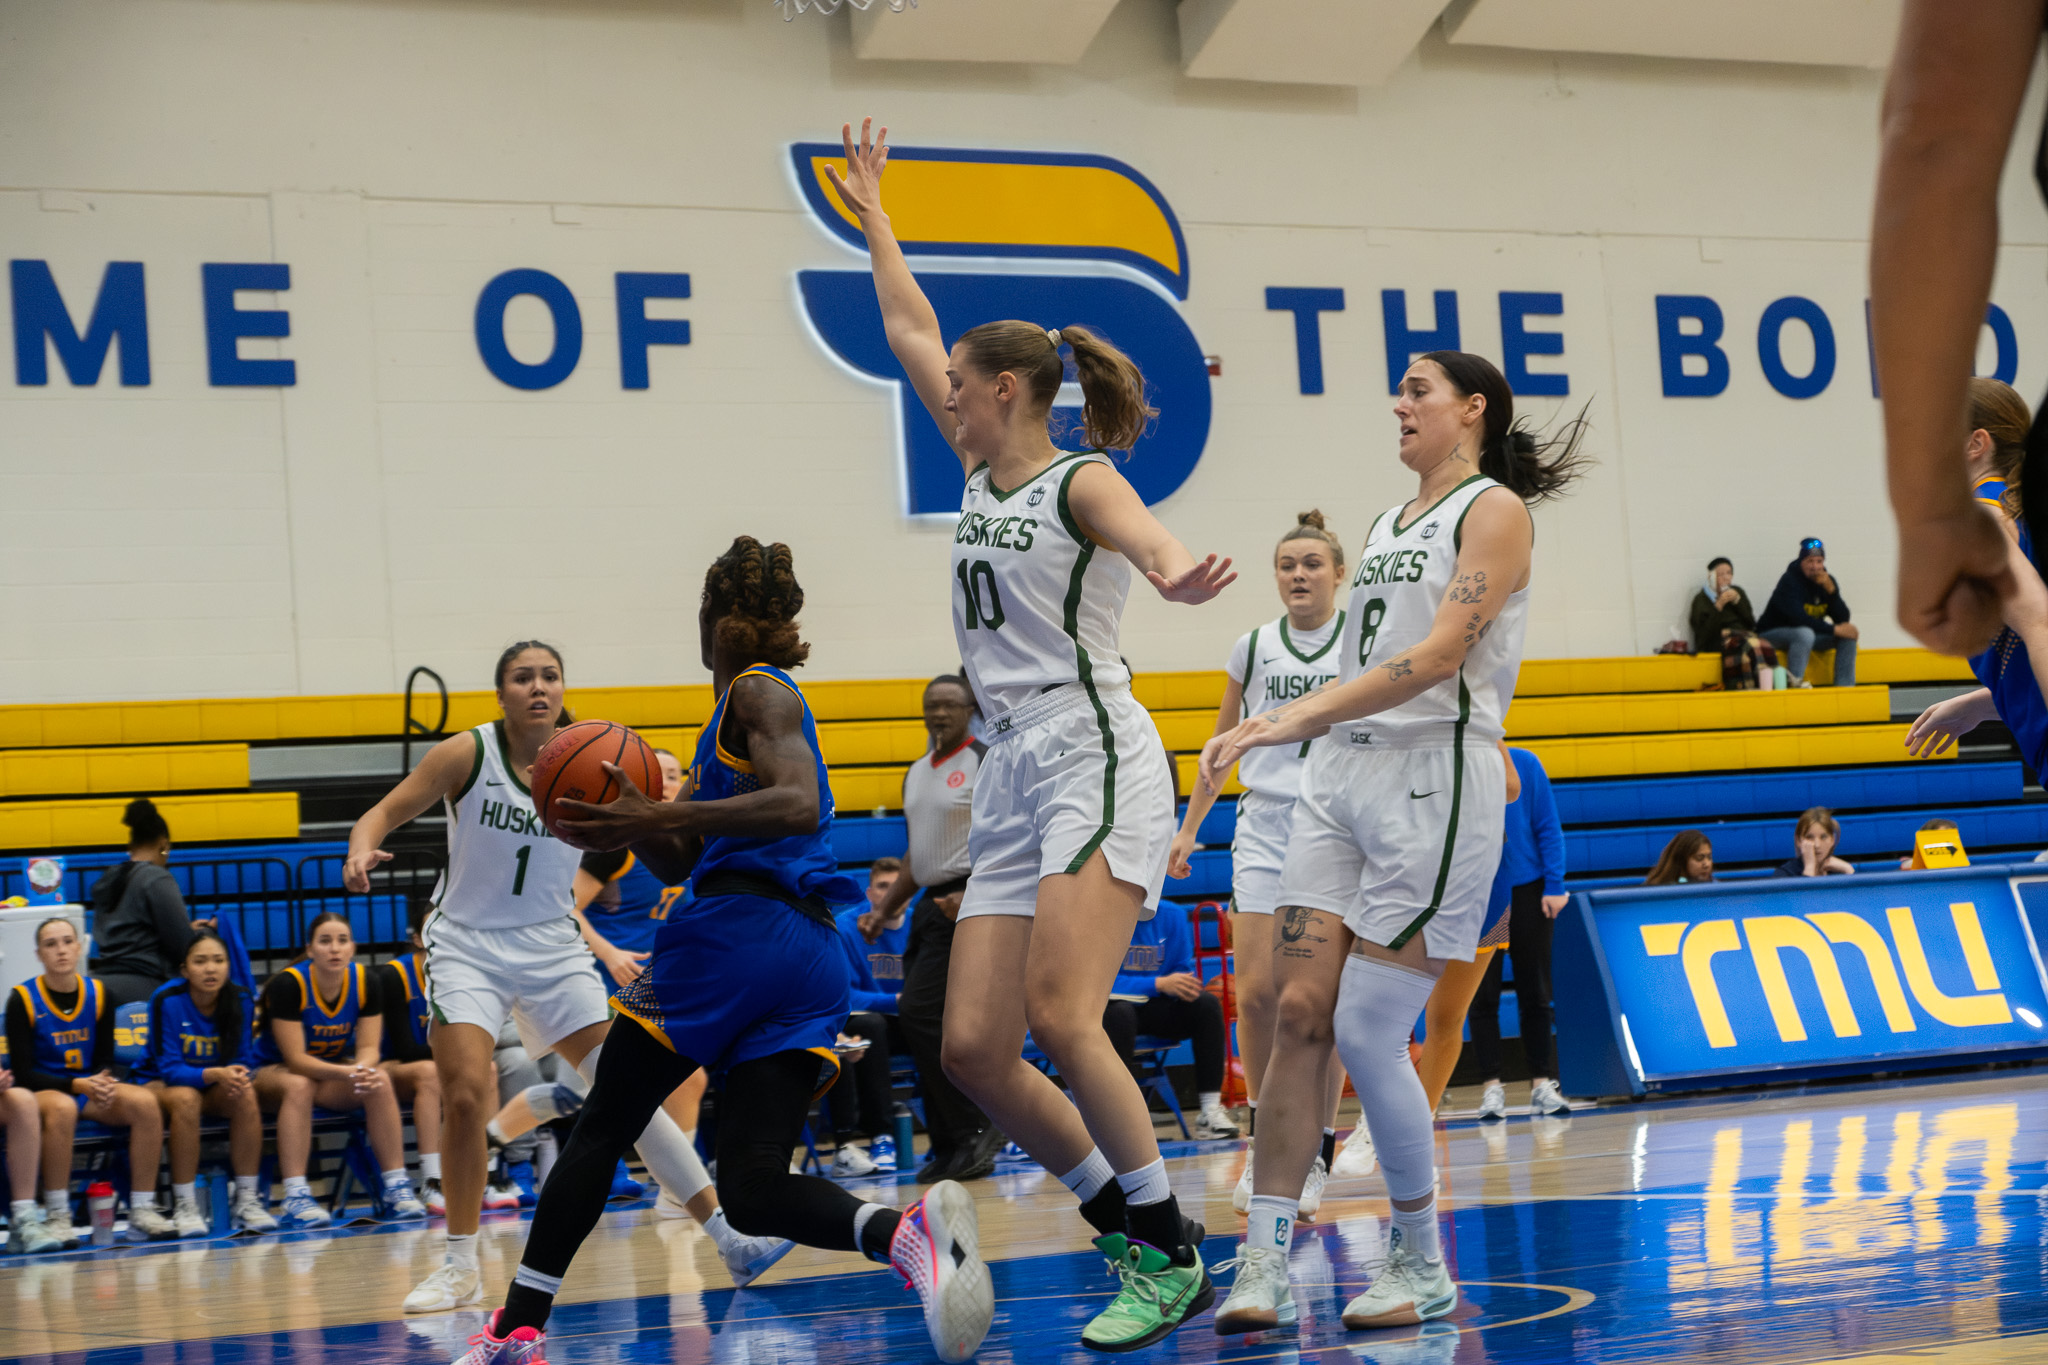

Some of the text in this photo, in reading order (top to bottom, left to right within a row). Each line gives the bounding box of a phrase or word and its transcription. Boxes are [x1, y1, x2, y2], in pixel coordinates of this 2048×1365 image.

[9, 259, 2019, 399] ME OF THE BOD
[954, 508, 1038, 552] USKIES
[957, 558, 1006, 631] 10
[1350, 549, 1428, 590] USKIES
[1359, 597, 1387, 667] 8
[511, 844, 531, 896] 1
[1640, 901, 2014, 1049] TMU
